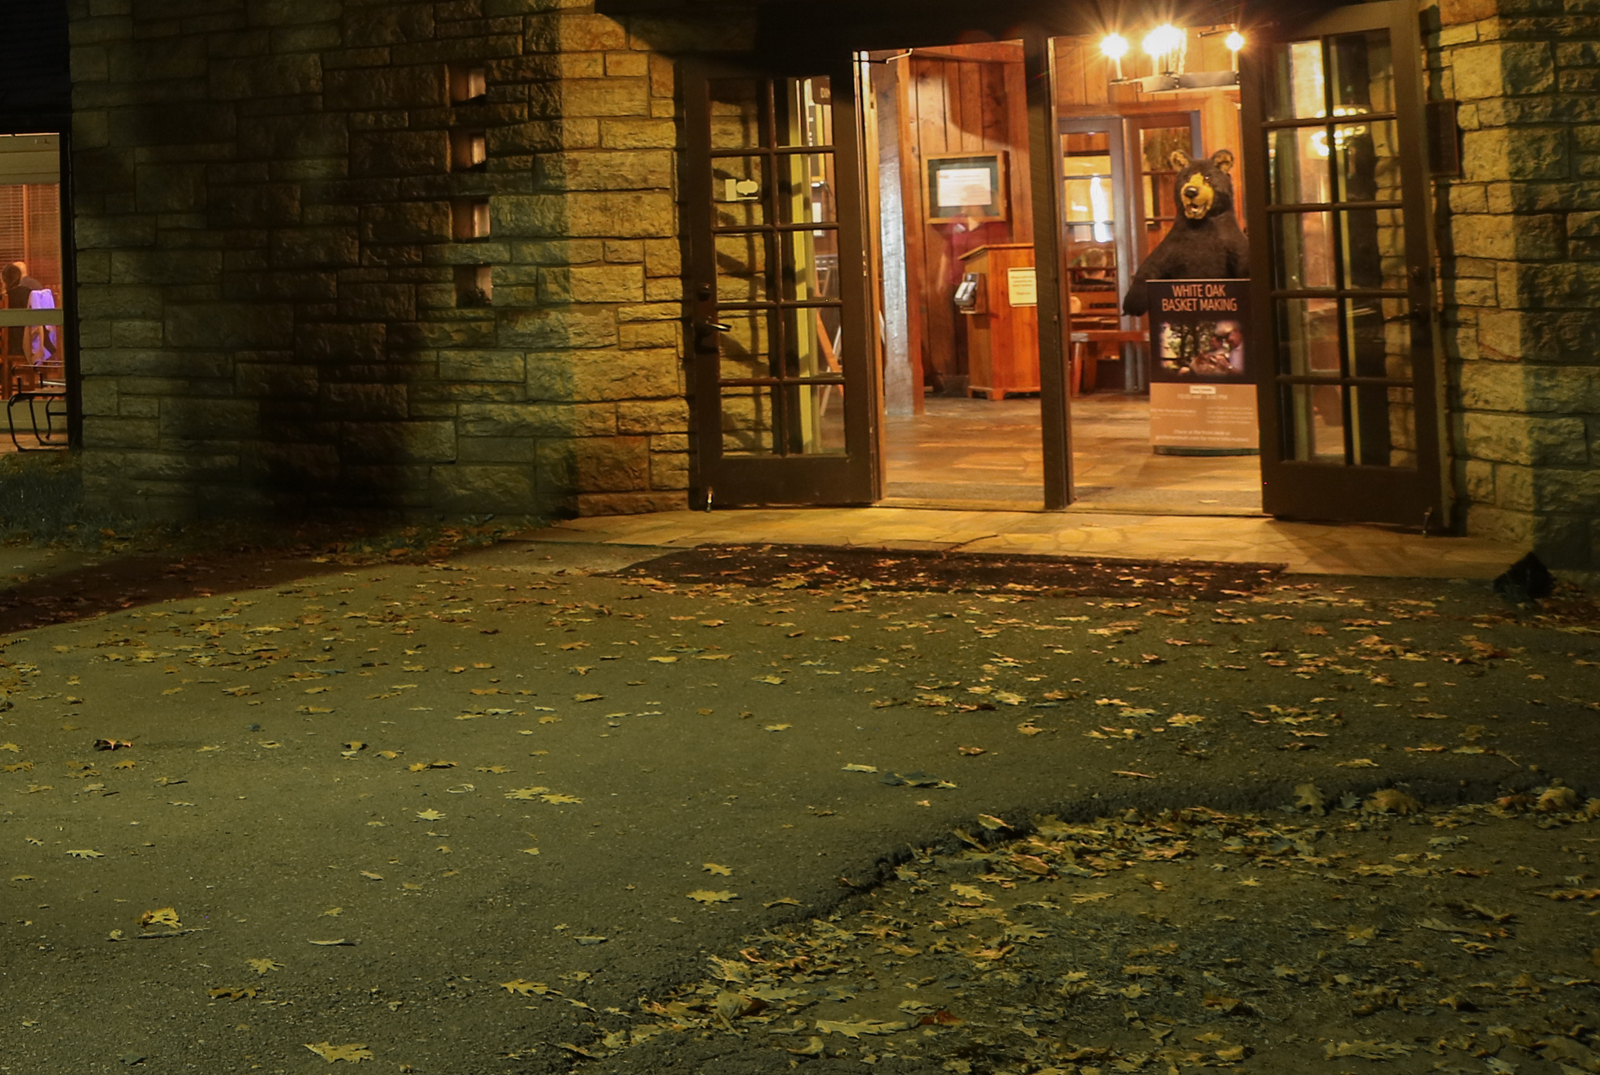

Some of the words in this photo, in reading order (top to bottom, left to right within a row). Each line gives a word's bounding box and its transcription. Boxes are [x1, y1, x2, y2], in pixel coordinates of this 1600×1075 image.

[1171, 284, 1203, 297] WHITE
[1205, 284, 1226, 297] OAK
[1161, 298, 1198, 312] BASKET
[1200, 298, 1238, 312] MAKING
